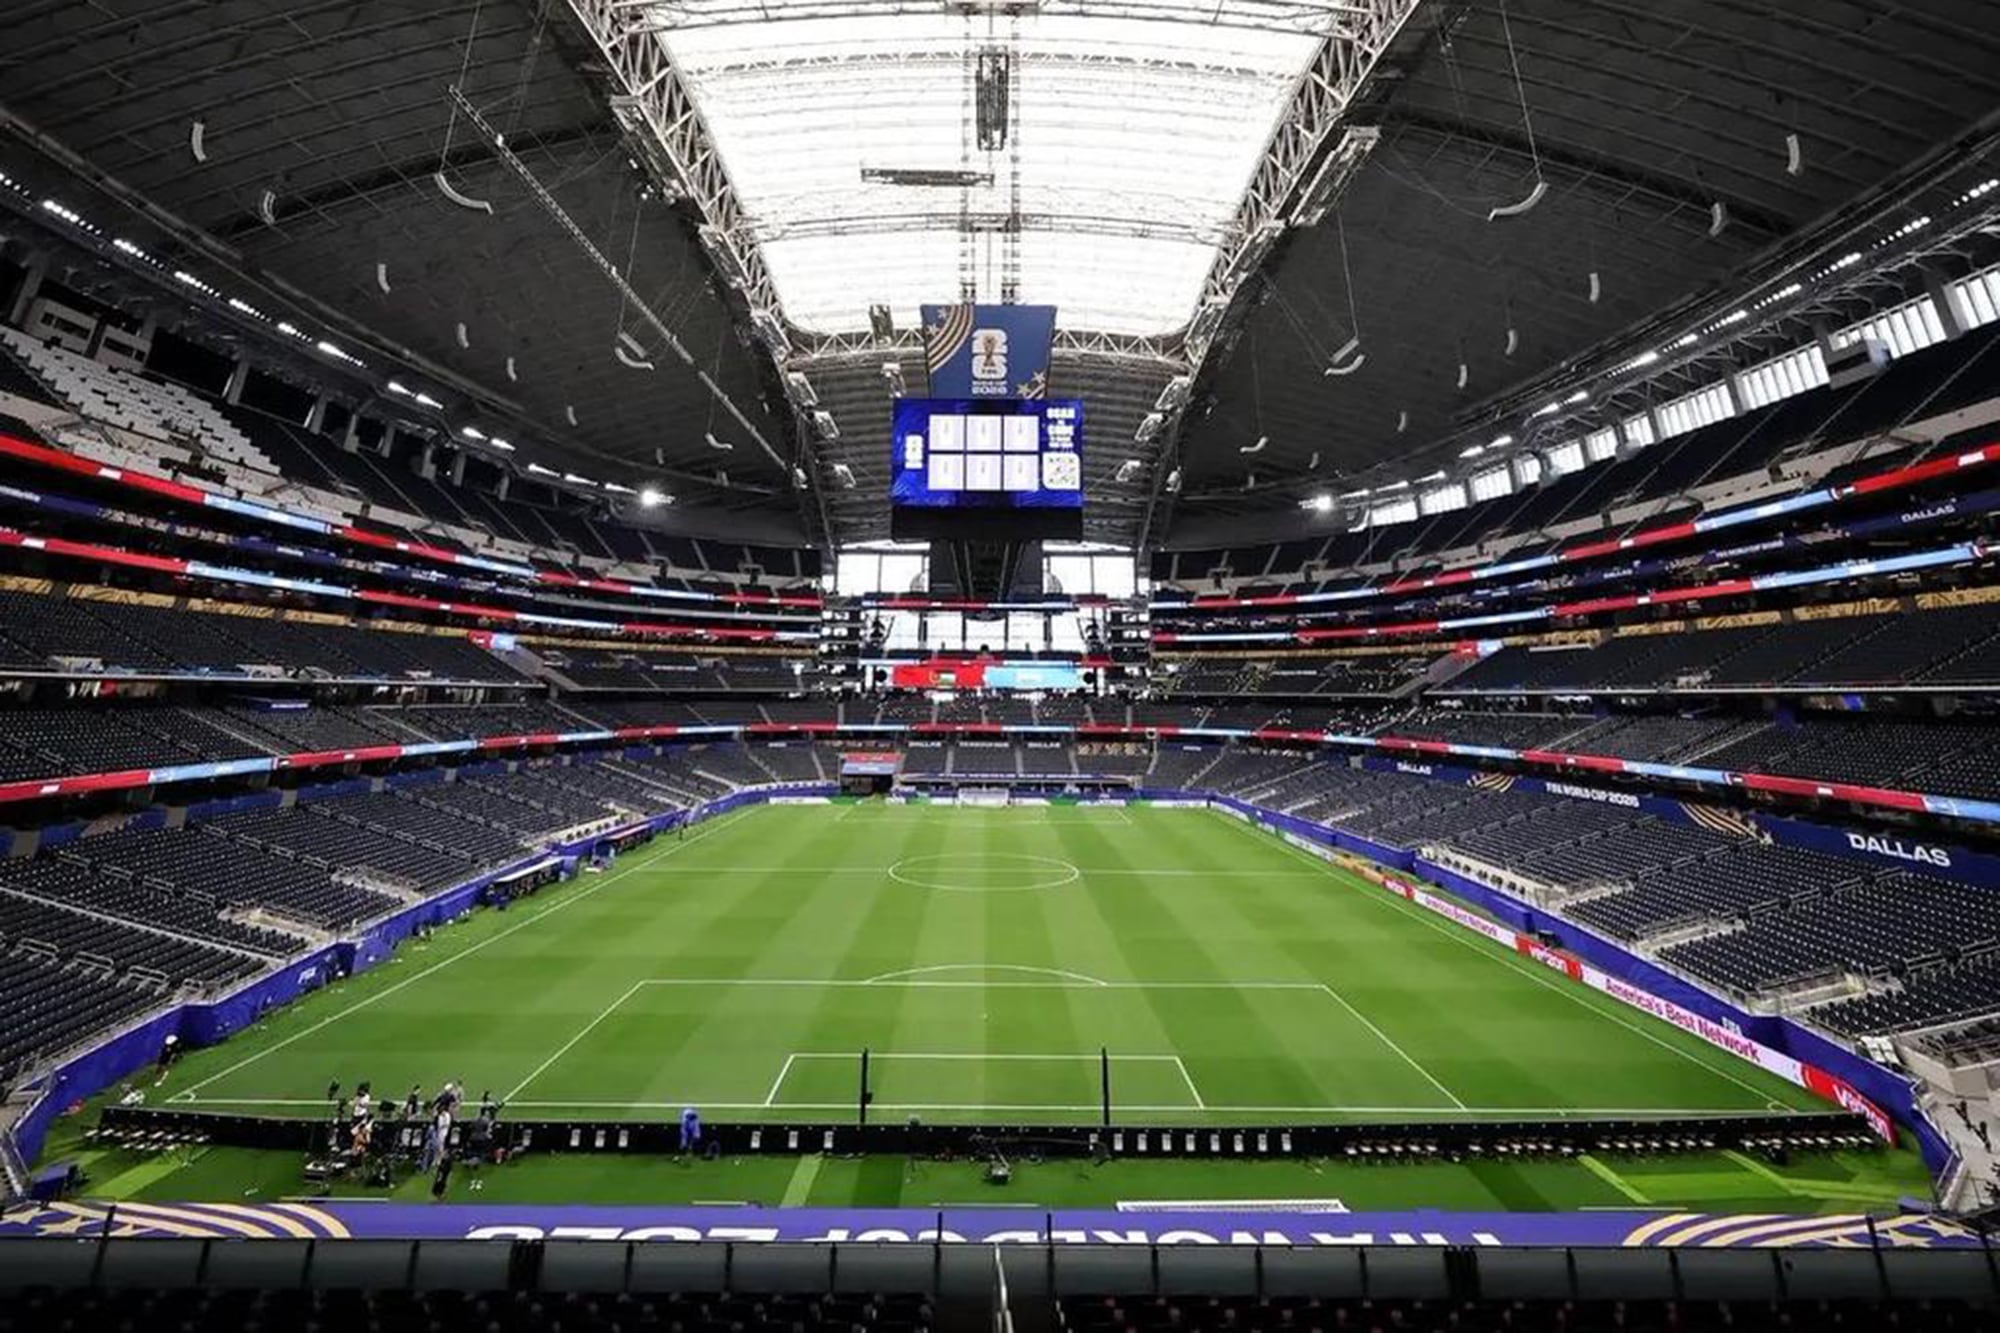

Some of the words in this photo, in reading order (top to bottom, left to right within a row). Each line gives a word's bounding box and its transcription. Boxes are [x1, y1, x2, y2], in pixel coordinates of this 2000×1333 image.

[1901, 504, 1956, 523] DALLAS
[1845, 832, 1951, 867] DALLAS
[1604, 978, 1664, 1015] America's
[1664, 1003, 1695, 1032] Best
[1697, 1020, 1761, 1062] Network
